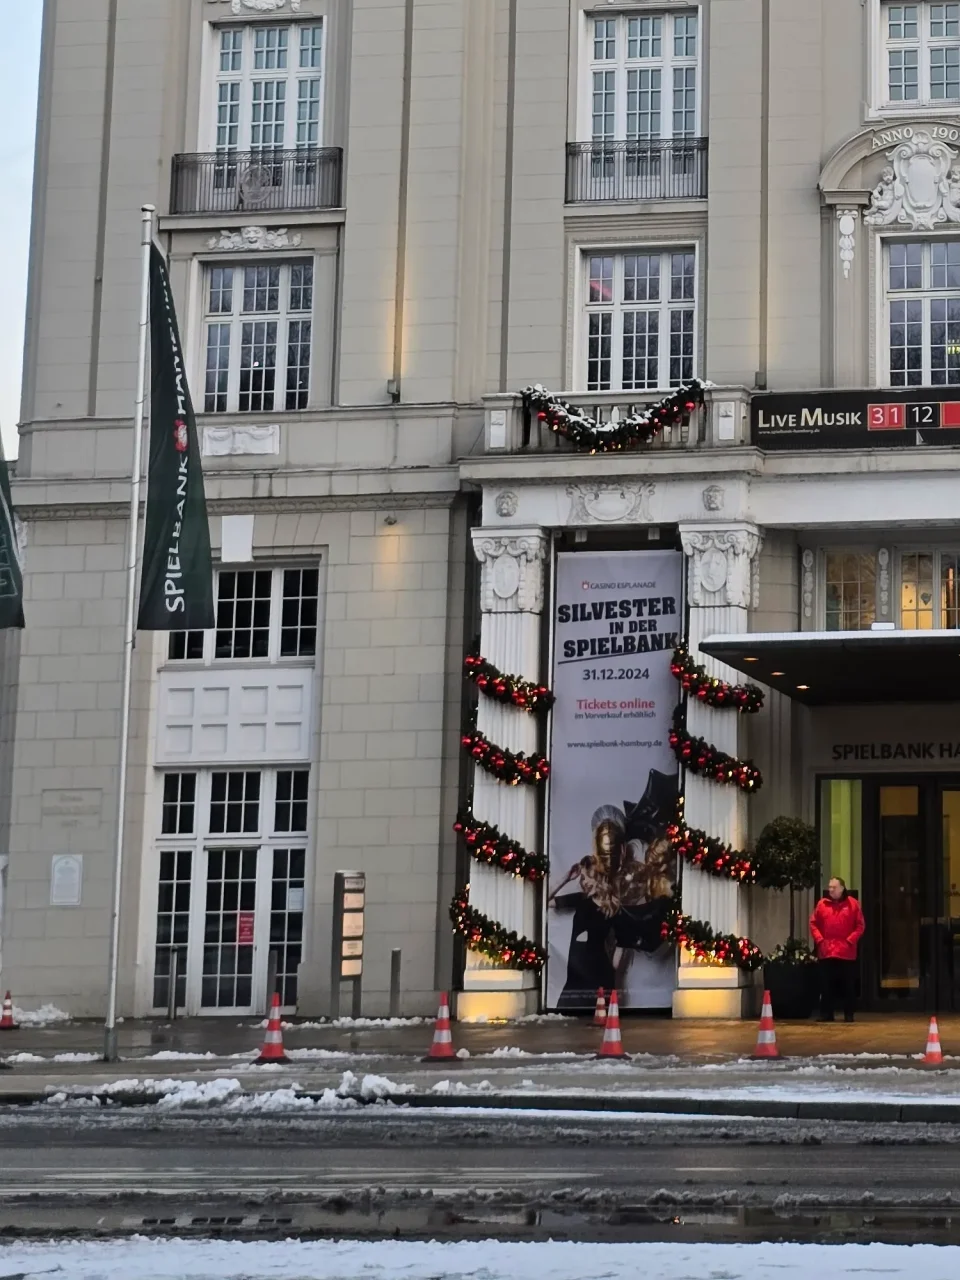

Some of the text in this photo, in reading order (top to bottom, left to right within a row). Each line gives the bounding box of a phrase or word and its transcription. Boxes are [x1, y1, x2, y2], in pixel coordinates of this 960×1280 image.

[912, 406, 933, 423] 12
[617, 581, 656, 589] ESPLANADE
[558, 596, 676, 623] SILVESTER
[609, 619, 657, 635] IN DER
[563, 632, 678, 658] SPIELBANK
[583, 668, 650, 680] 31.12.2024
[576, 698, 656, 710] Tickets online
[585, 711, 622, 720] Vorverkauf
[623, 710, 656, 719] erhältlich
[832, 742, 935, 760] SPIELBANK
